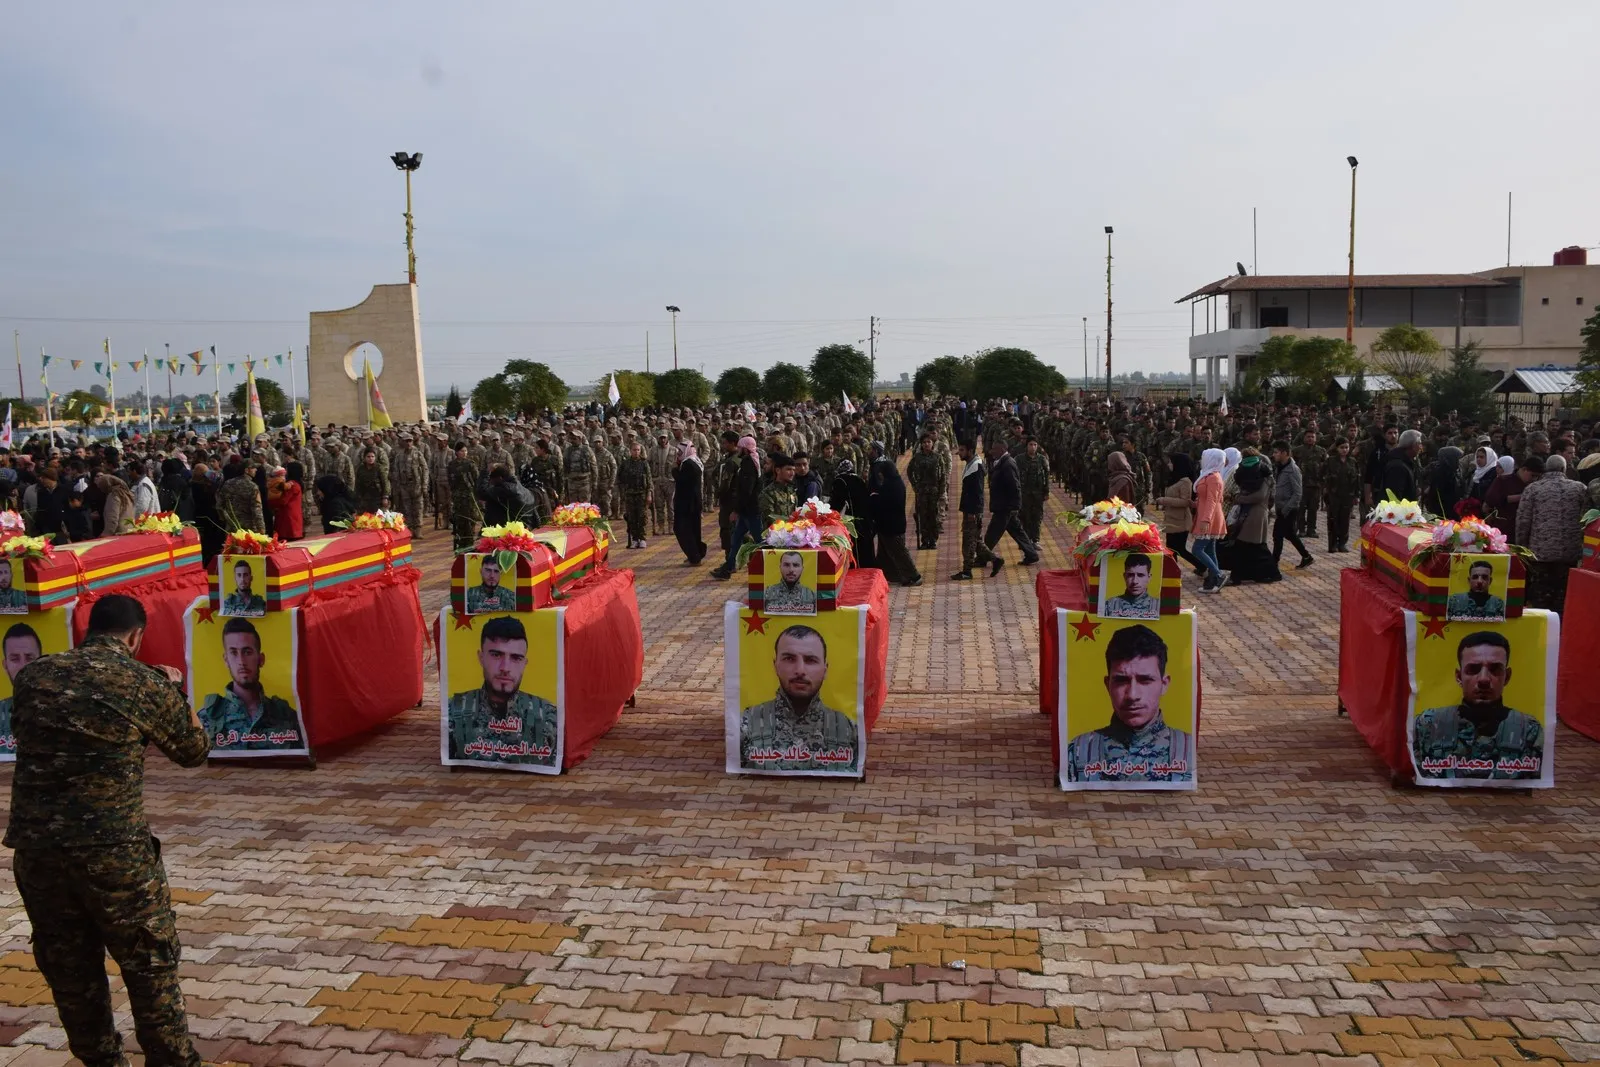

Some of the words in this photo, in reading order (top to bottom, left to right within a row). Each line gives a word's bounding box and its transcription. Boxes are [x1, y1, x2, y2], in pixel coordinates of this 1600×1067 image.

[488, 716, 522, 733] الشهيد
[241, 732, 267, 742] محمد
[269, 730, 298, 744] الشهيد
[464, 736, 494, 757] يونس
[494, 740, 528, 758] الحميد
[529, 742, 551, 759] عبد
[784, 744, 812, 763] خالد
[749, 747, 783, 764] حديد
[814, 746, 853, 766] الشهيد
[1421, 755, 1457, 773] العبيد
[1457, 757, 1494, 770] محمد
[1084, 760, 1122, 777] ابراهيم
[1124, 760, 1149, 775] ايمن
[1152, 760, 1187, 776] الشهيد
[1497, 756, 1540, 774] الشهيد
